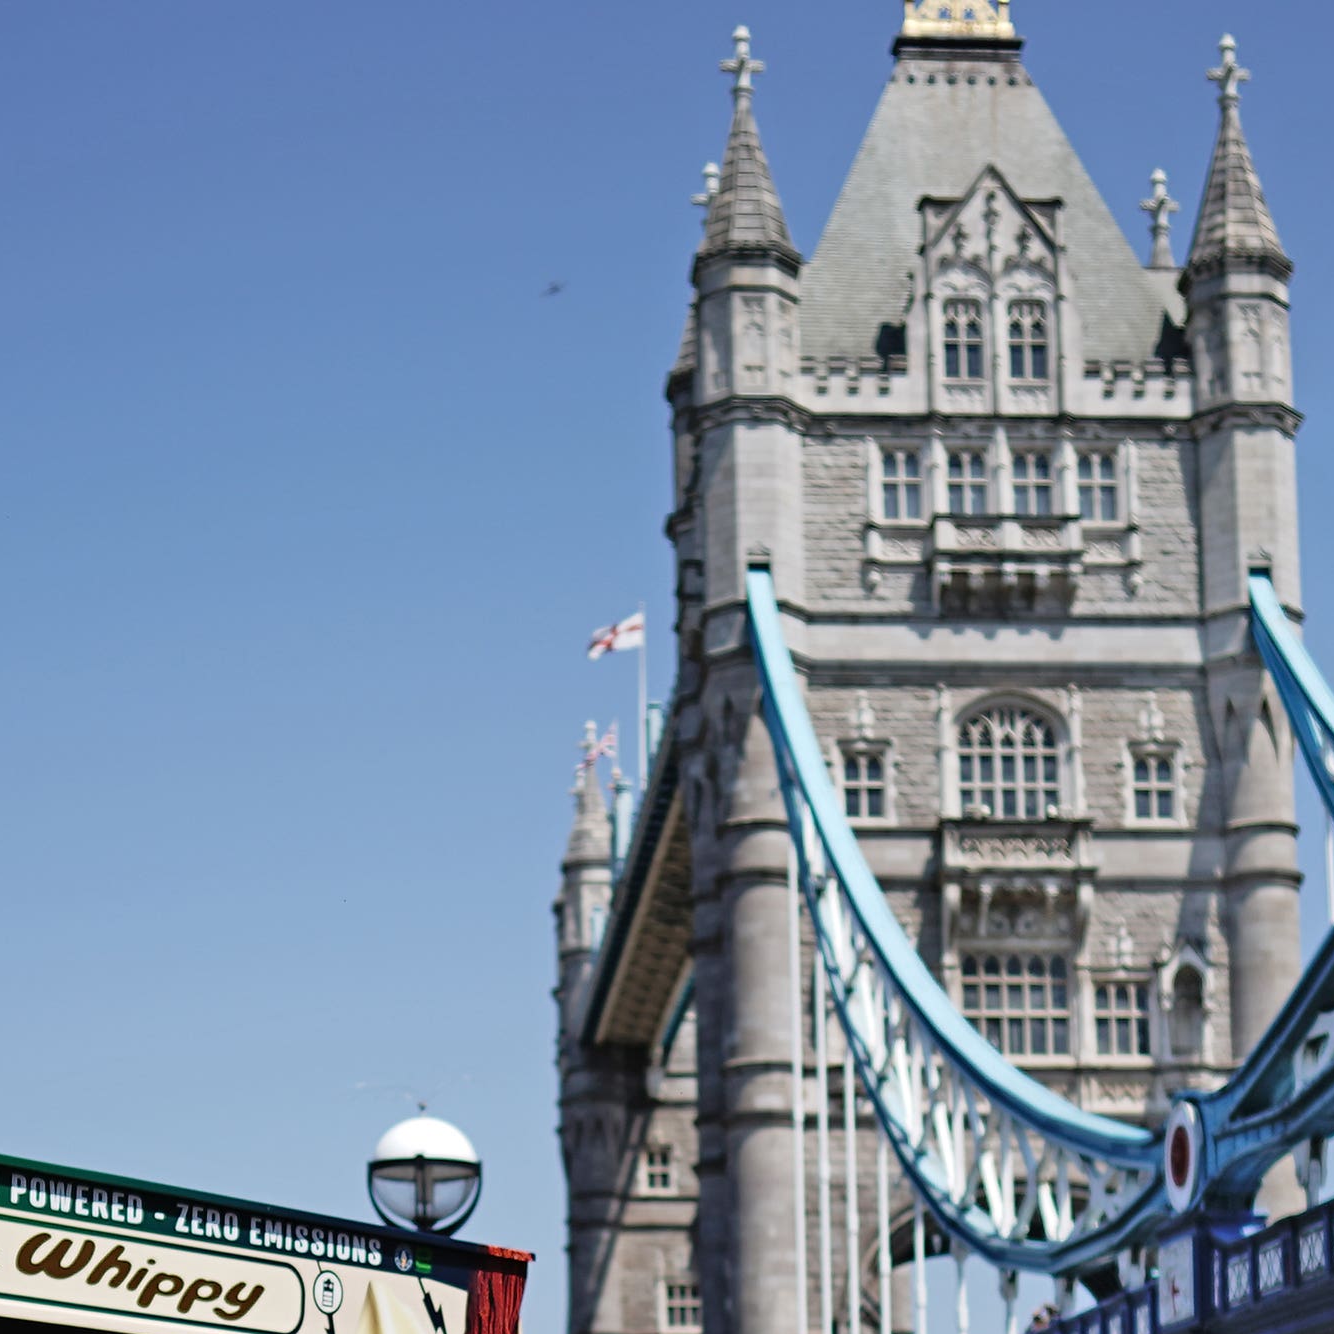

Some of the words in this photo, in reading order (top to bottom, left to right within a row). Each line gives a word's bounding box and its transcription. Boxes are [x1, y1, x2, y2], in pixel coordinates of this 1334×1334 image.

[10, 1173, 144, 1225] POWERED
[175, 1203, 240, 1242] ZERO
[249, 1217, 383, 1267] EMISSIONS
[16, 1232, 265, 1321] Whippy
